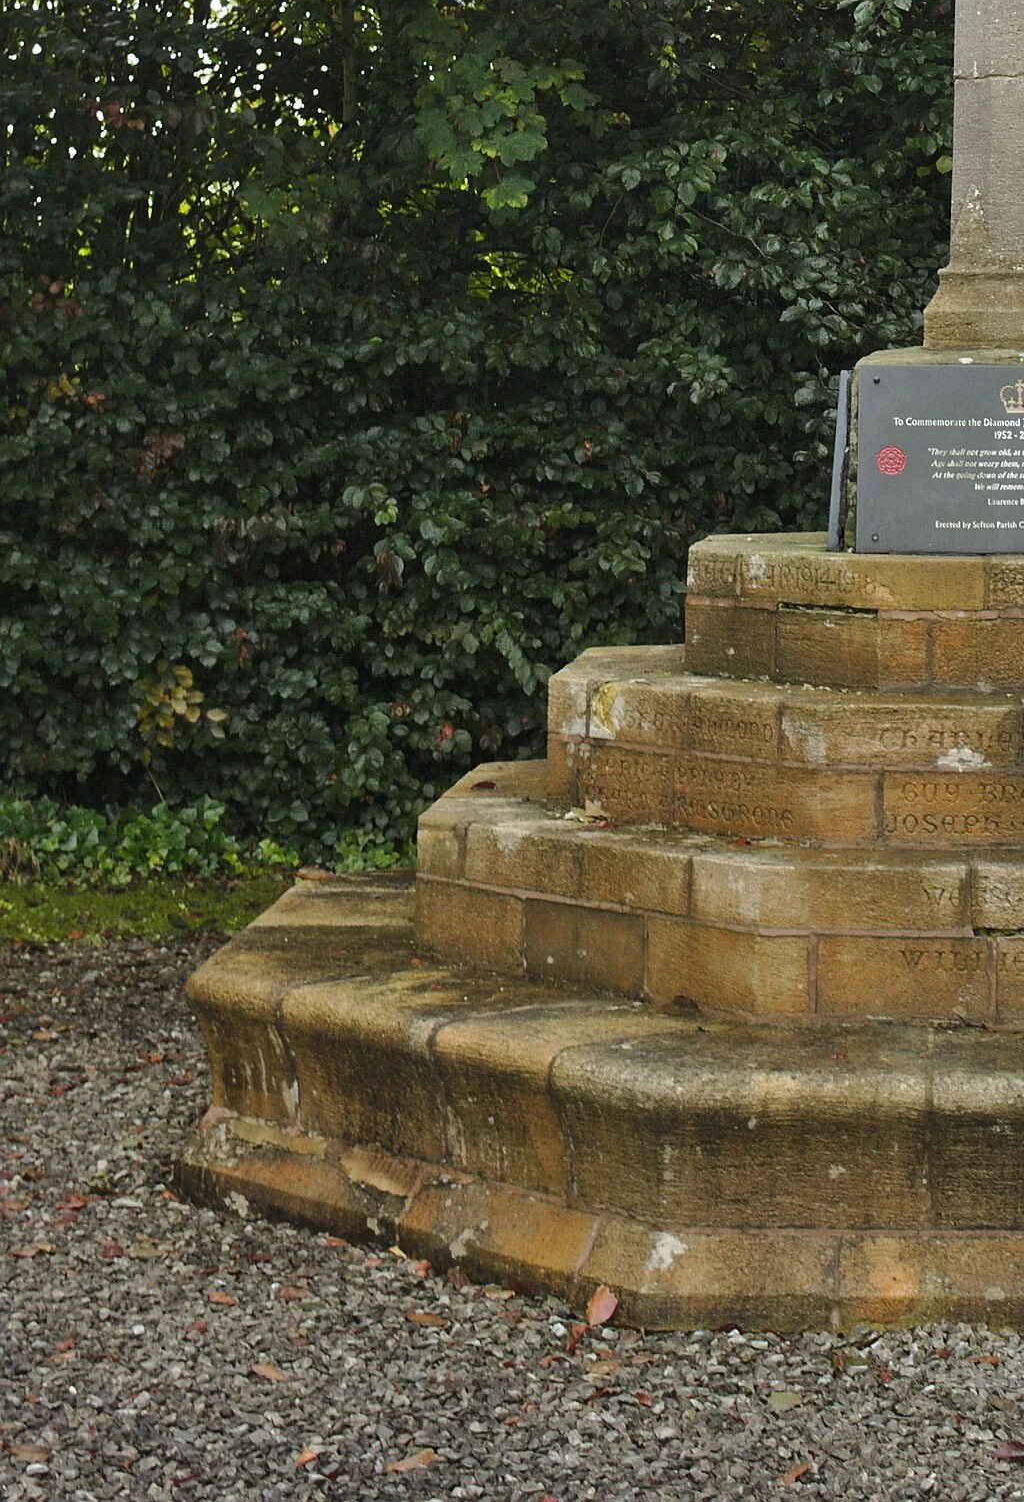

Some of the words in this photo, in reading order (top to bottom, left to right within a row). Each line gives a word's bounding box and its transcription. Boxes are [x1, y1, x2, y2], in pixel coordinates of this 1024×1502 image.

[893, 417, 904, 428] To
[905, 417, 966, 428] Commemorate
[968, 417, 981, 428] the
[983, 417, 1020, 428] Diamond
[994, 430, 1012, 439] 1952
[949, 447, 965, 457] shall
[966, 447, 978, 457] not
[979, 447, 996, 457] grow
[998, 447, 1012, 457] old,
[1013, 447, 1021, 457] as
[931, 459, 945, 468] Age
[947, 459, 964, 468] shall
[964, 459, 977, 468] not
[978, 459, 1000, 468] weary
[1000, 459, 1020, 468] them,
[932, 471, 942, 480] At
[943, 471, 954, 480] the
[956, 471, 976, 480] going
[977, 471, 996, 480] down
[997, 471, 1006, 480] of
[1007, 471, 1018, 480] the
[974, 482, 985, 491] We
[986, 482, 999, 491] will
[987, 497, 1018, 506] Laurence
[935, 520, 961, 529] Erected
[962, 520, 971, 529] by
[972, 520, 995, 529] Sefton
[996, 520, 1018, 529] Parish
[902, 782, 959, 803] GUY
[883, 813, 1000, 834] JOSEPH
